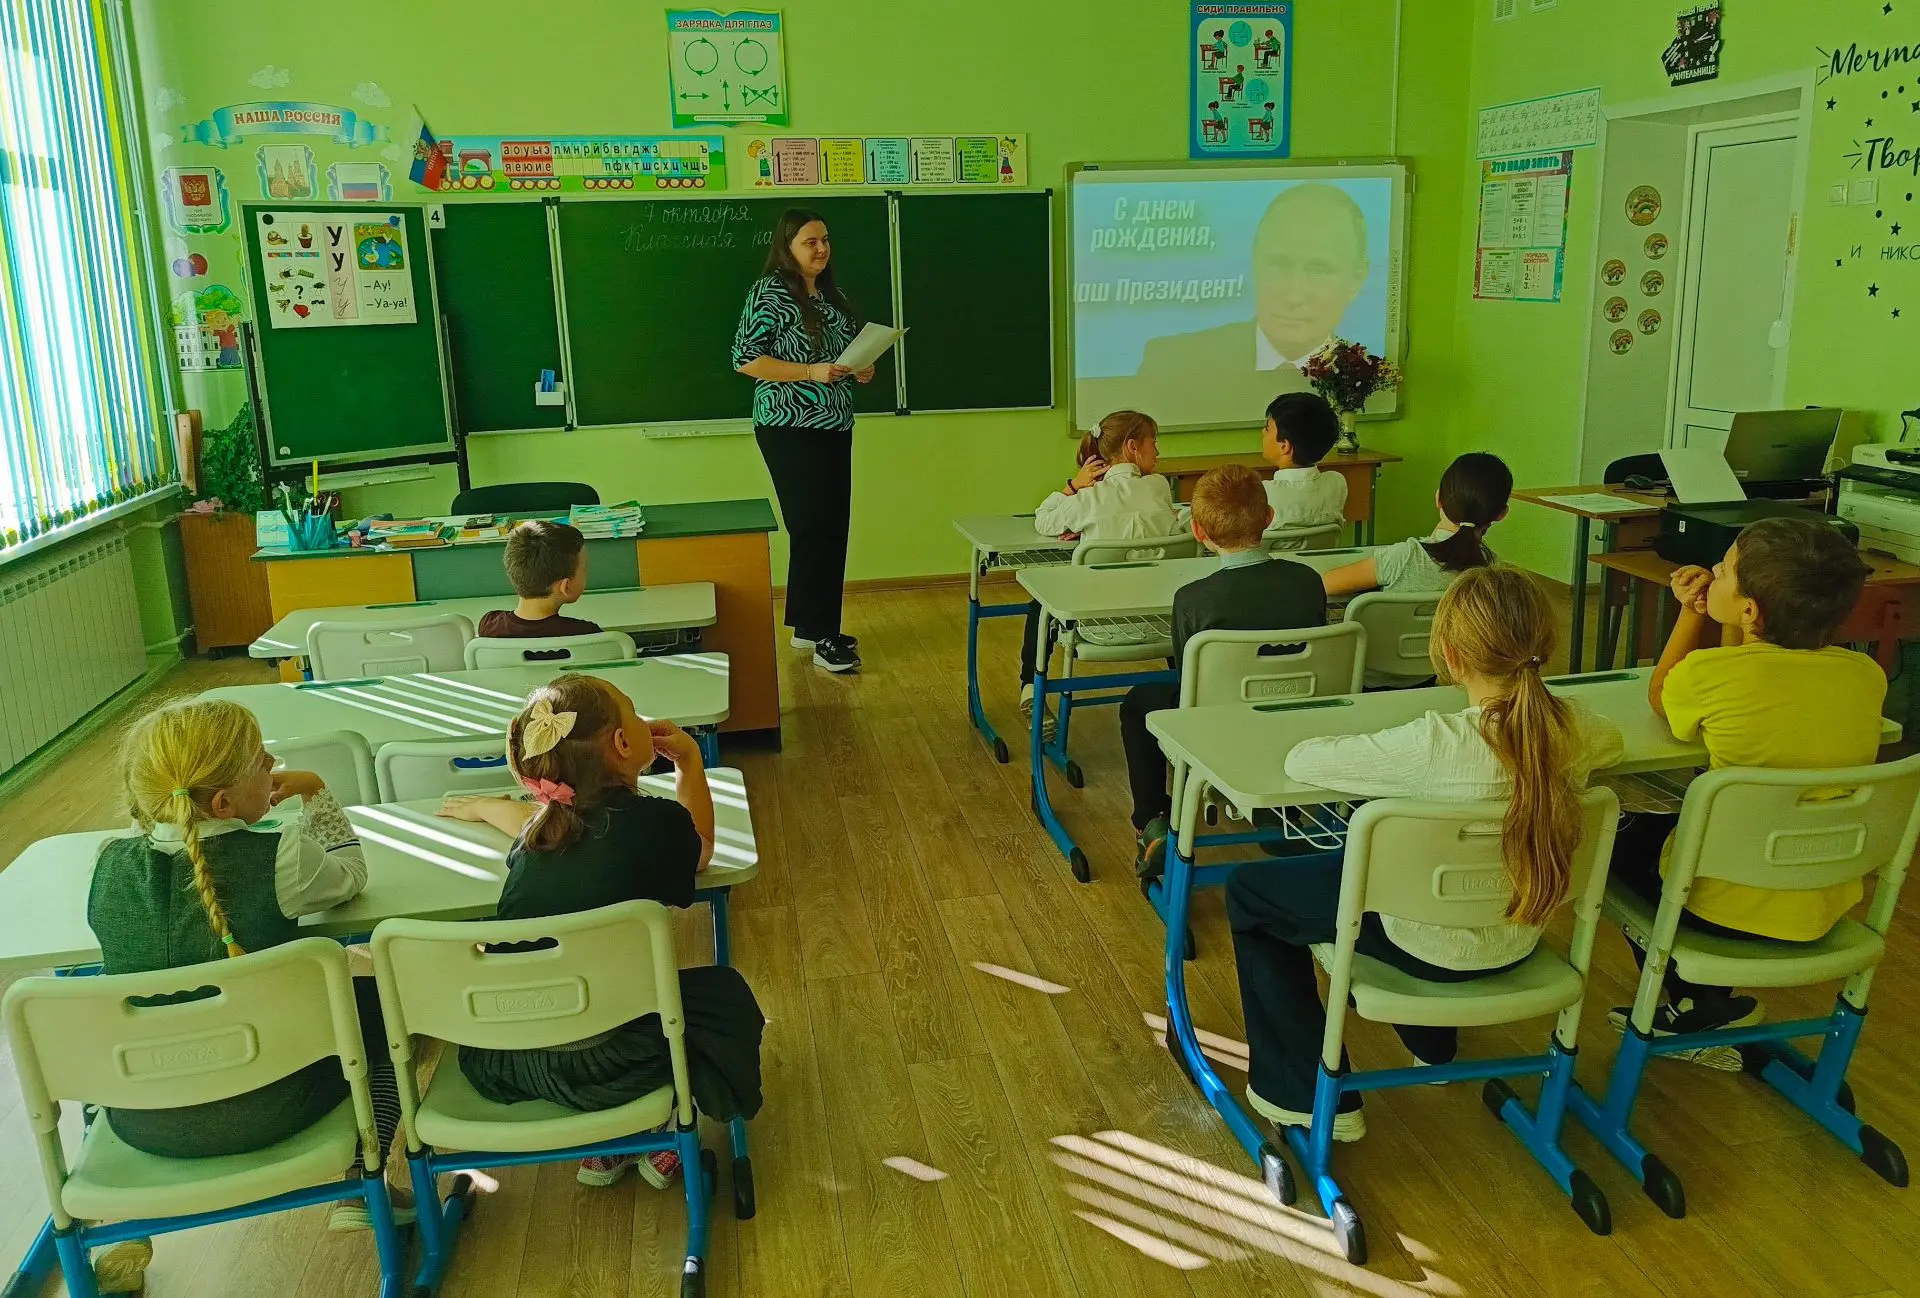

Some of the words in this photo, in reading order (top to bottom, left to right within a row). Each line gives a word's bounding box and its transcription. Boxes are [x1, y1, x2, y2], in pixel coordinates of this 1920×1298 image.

[1197, 5, 1225, 14] СИДИ
[1226, 5, 1286, 14] ПРАВИЛЬНО
[676, 20, 721, 29] ЗАРЯДКА
[724, 20, 745, 30] ДЛЯ
[748, 20, 772, 29] ГЛАЗ
[234, 109, 280, 124] НАША
[284, 109, 341, 125] РОССИЯ
[775, 151, 783, 183] 1
[823, 150, 830, 182] 1
[870, 150, 877, 182] 1
[914, 150, 921, 181] 1
[958, 150, 965, 181] 1
[431, 210, 441, 224] 4
[644, 202, 655, 223] 7
[1113, 196, 1127, 221] С
[1132, 198, 1196, 224] днем
[1090, 224, 1216, 253] рождения,
[1850, 243, 1863, 260] И
[1073, 281, 1110, 303] аш
[1115, 273, 1244, 305] Президент!
